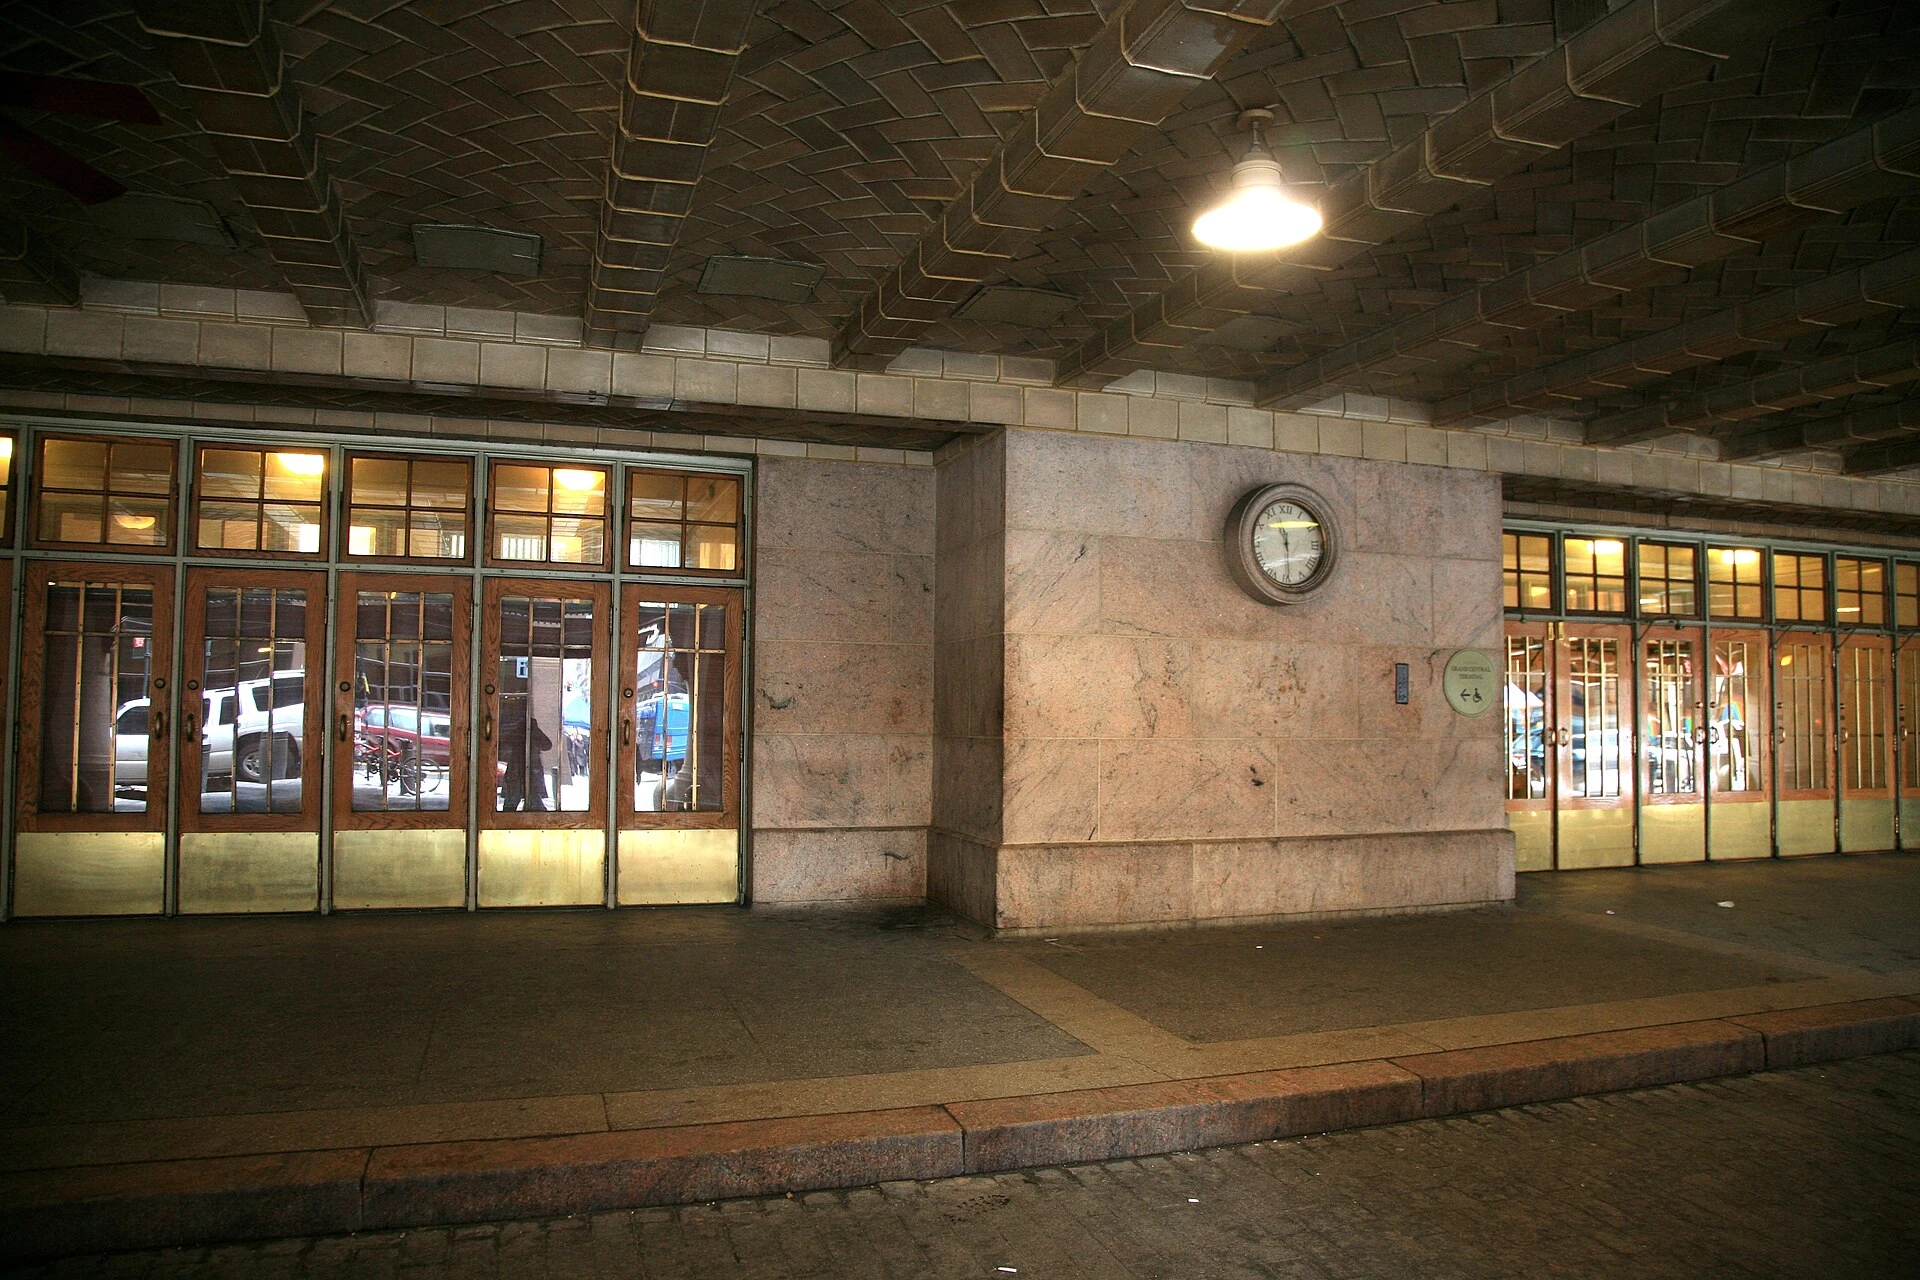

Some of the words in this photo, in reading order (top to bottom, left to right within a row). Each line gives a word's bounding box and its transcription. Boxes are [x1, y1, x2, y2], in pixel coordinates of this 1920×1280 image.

[1264, 507, 1277, 519] XI
[1278, 505, 1293, 514] XII
[1297, 511, 1303, 519] I
[1311, 540, 1319, 551] III
[1298, 571, 1306, 579] V
